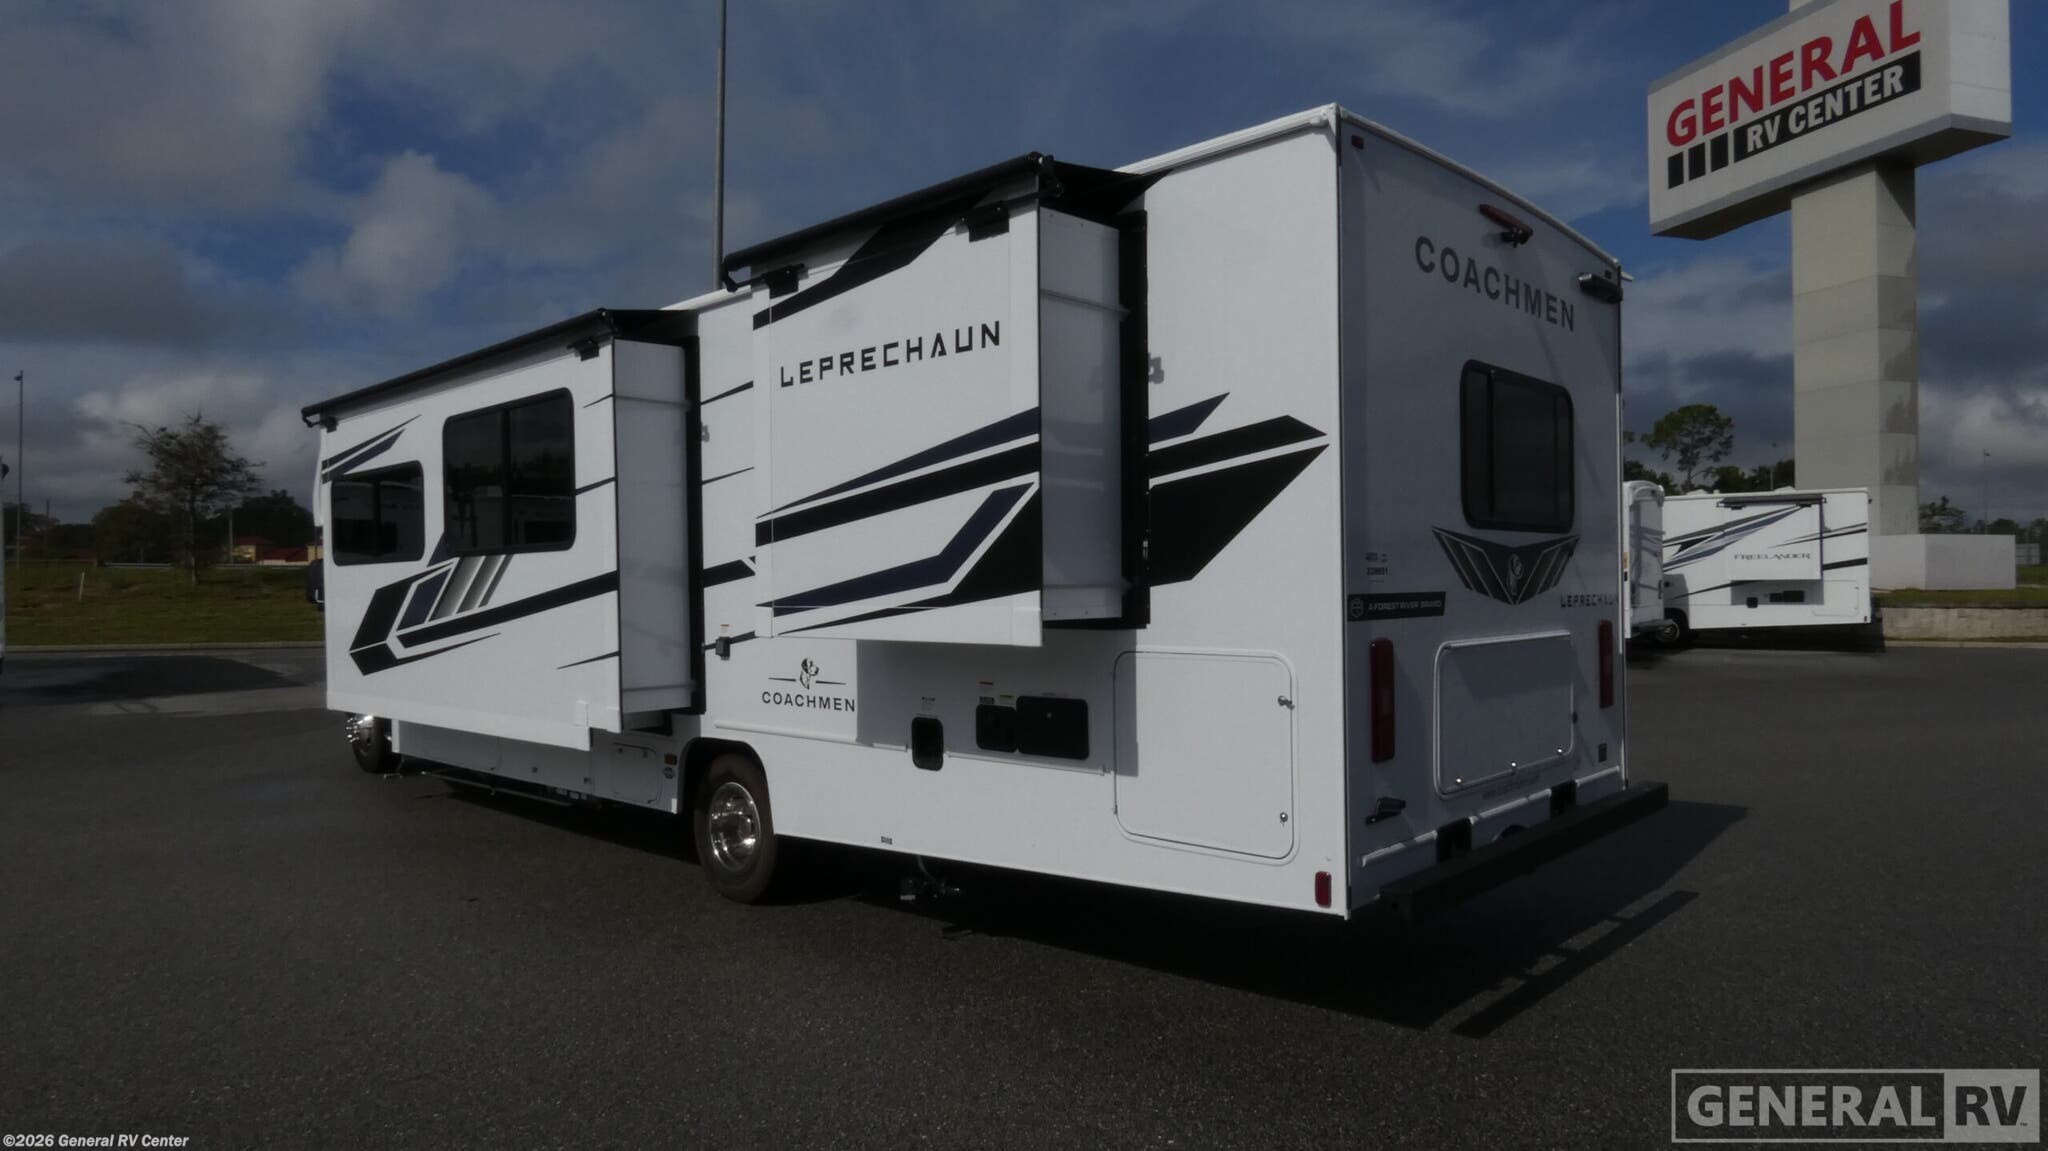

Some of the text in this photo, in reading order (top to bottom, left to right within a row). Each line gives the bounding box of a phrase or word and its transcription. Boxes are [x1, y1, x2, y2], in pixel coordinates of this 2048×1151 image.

[1666, 0, 1921, 147] GENERAL
[1746, 65, 1904, 154] RV CENTER
[1415, 235, 1575, 332] COACHMEN
[780, 320, 1000, 388] LEPRECHAUN
[1733, 552, 1811, 561] FREELANDER
[761, 690, 856, 712] COACHMEN
